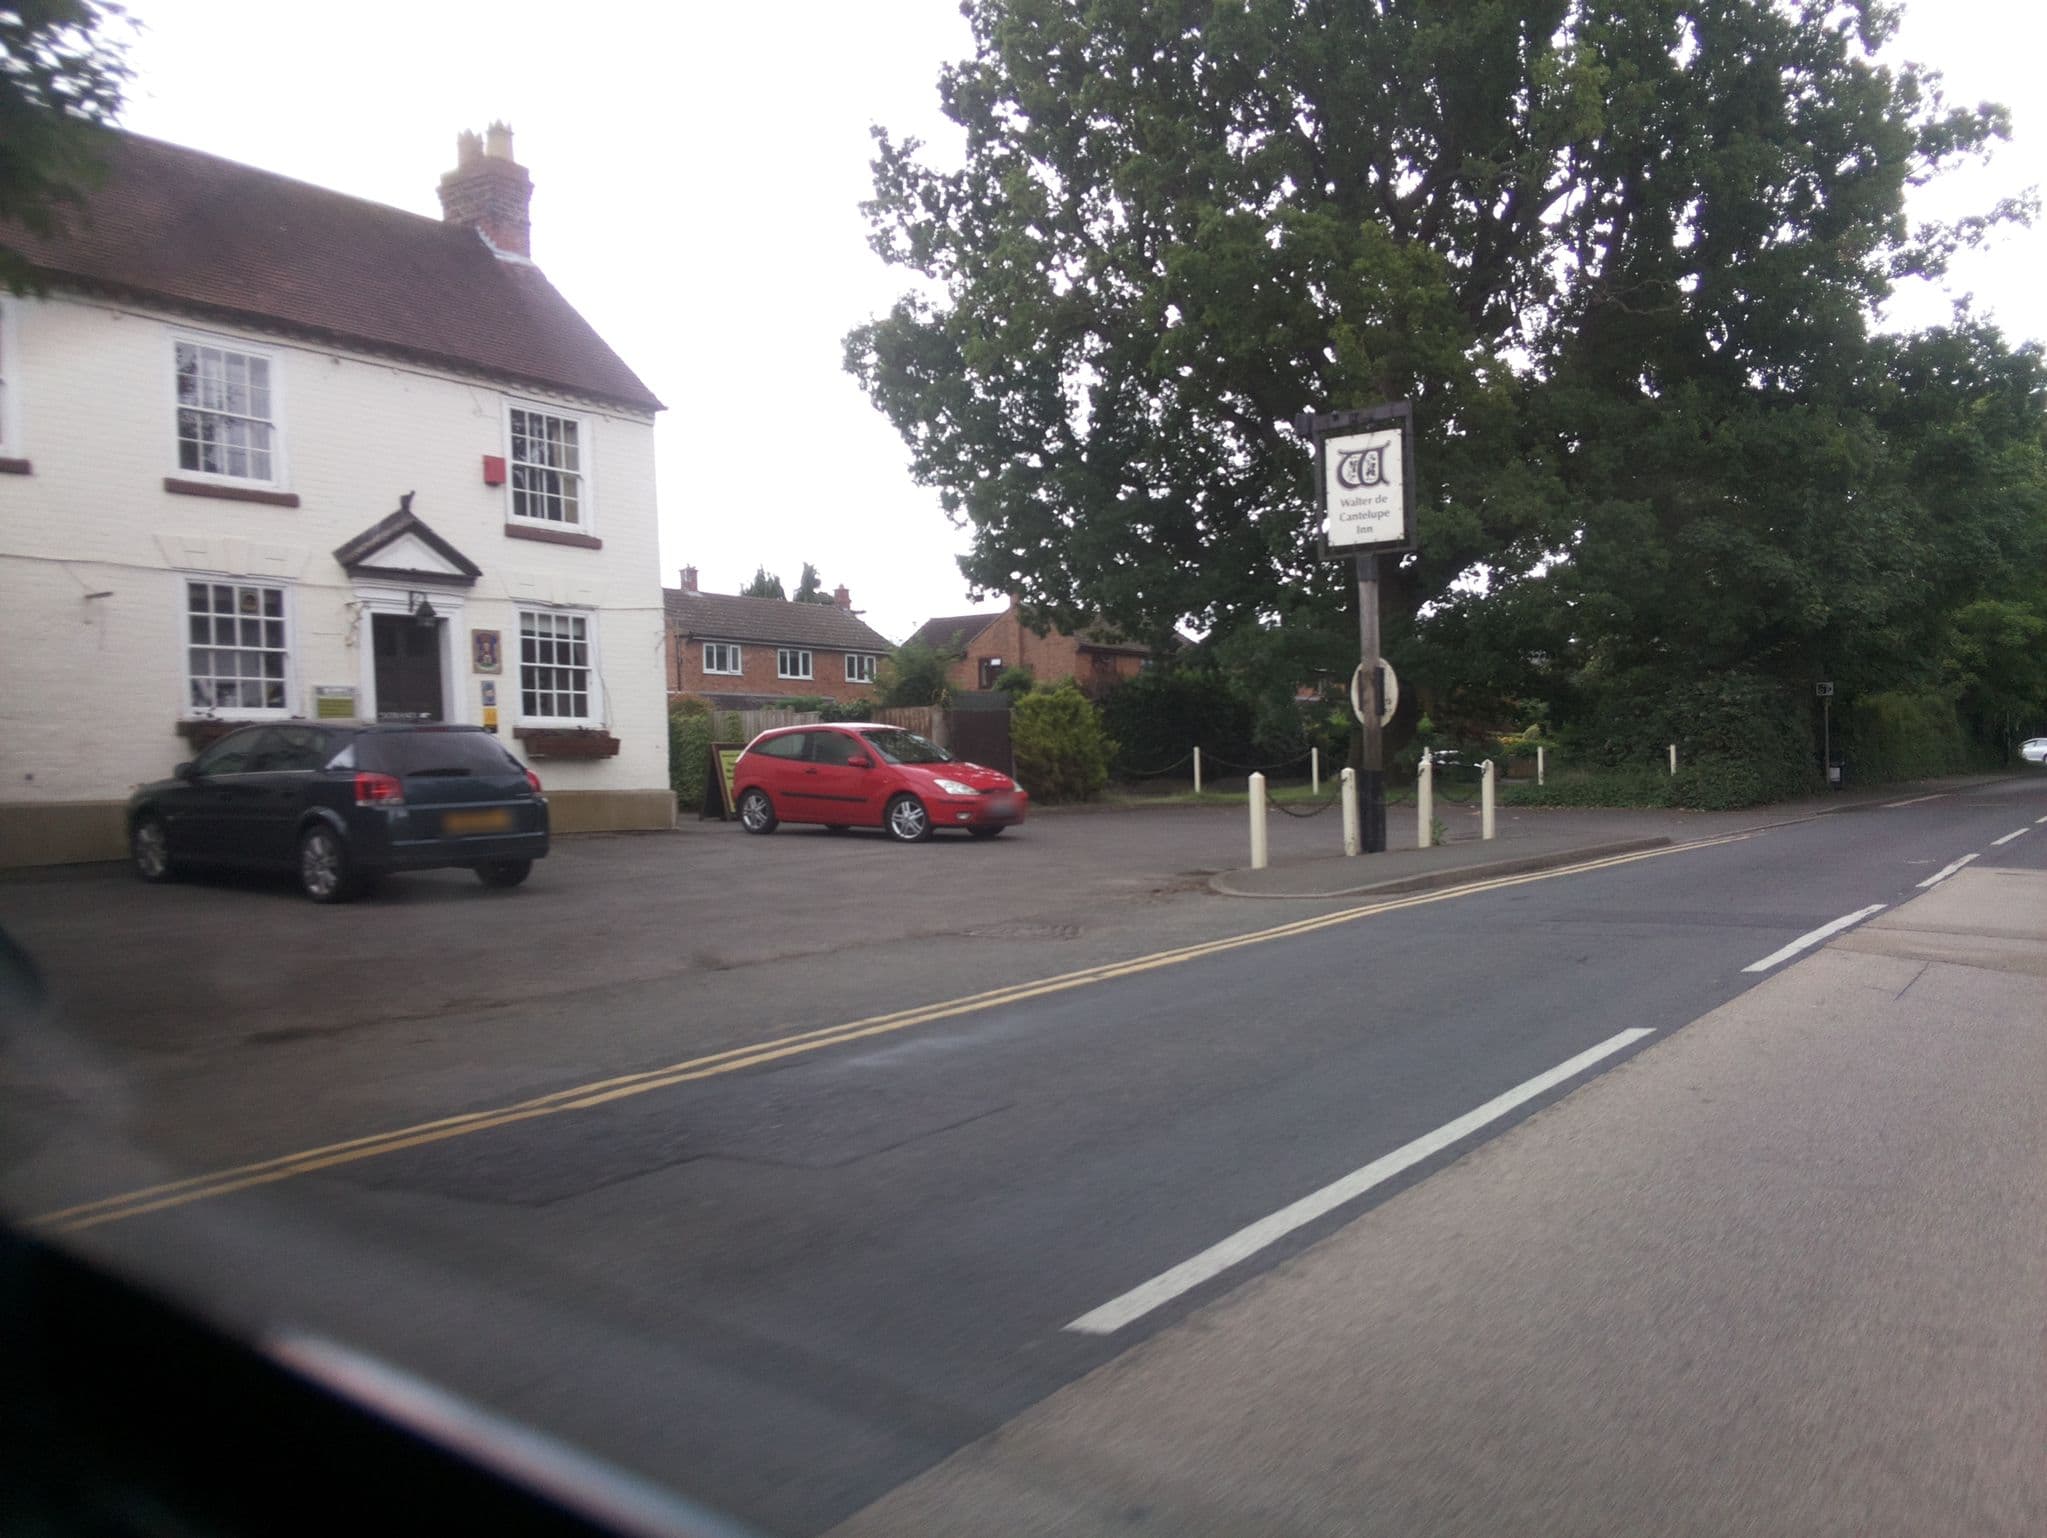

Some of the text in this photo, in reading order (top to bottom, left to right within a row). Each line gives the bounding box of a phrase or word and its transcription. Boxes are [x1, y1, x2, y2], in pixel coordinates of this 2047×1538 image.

[1340, 494, 1389, 508] Walter de
[1339, 509, 1391, 521] Cantelupe
[1356, 525, 1374, 535] Inn
